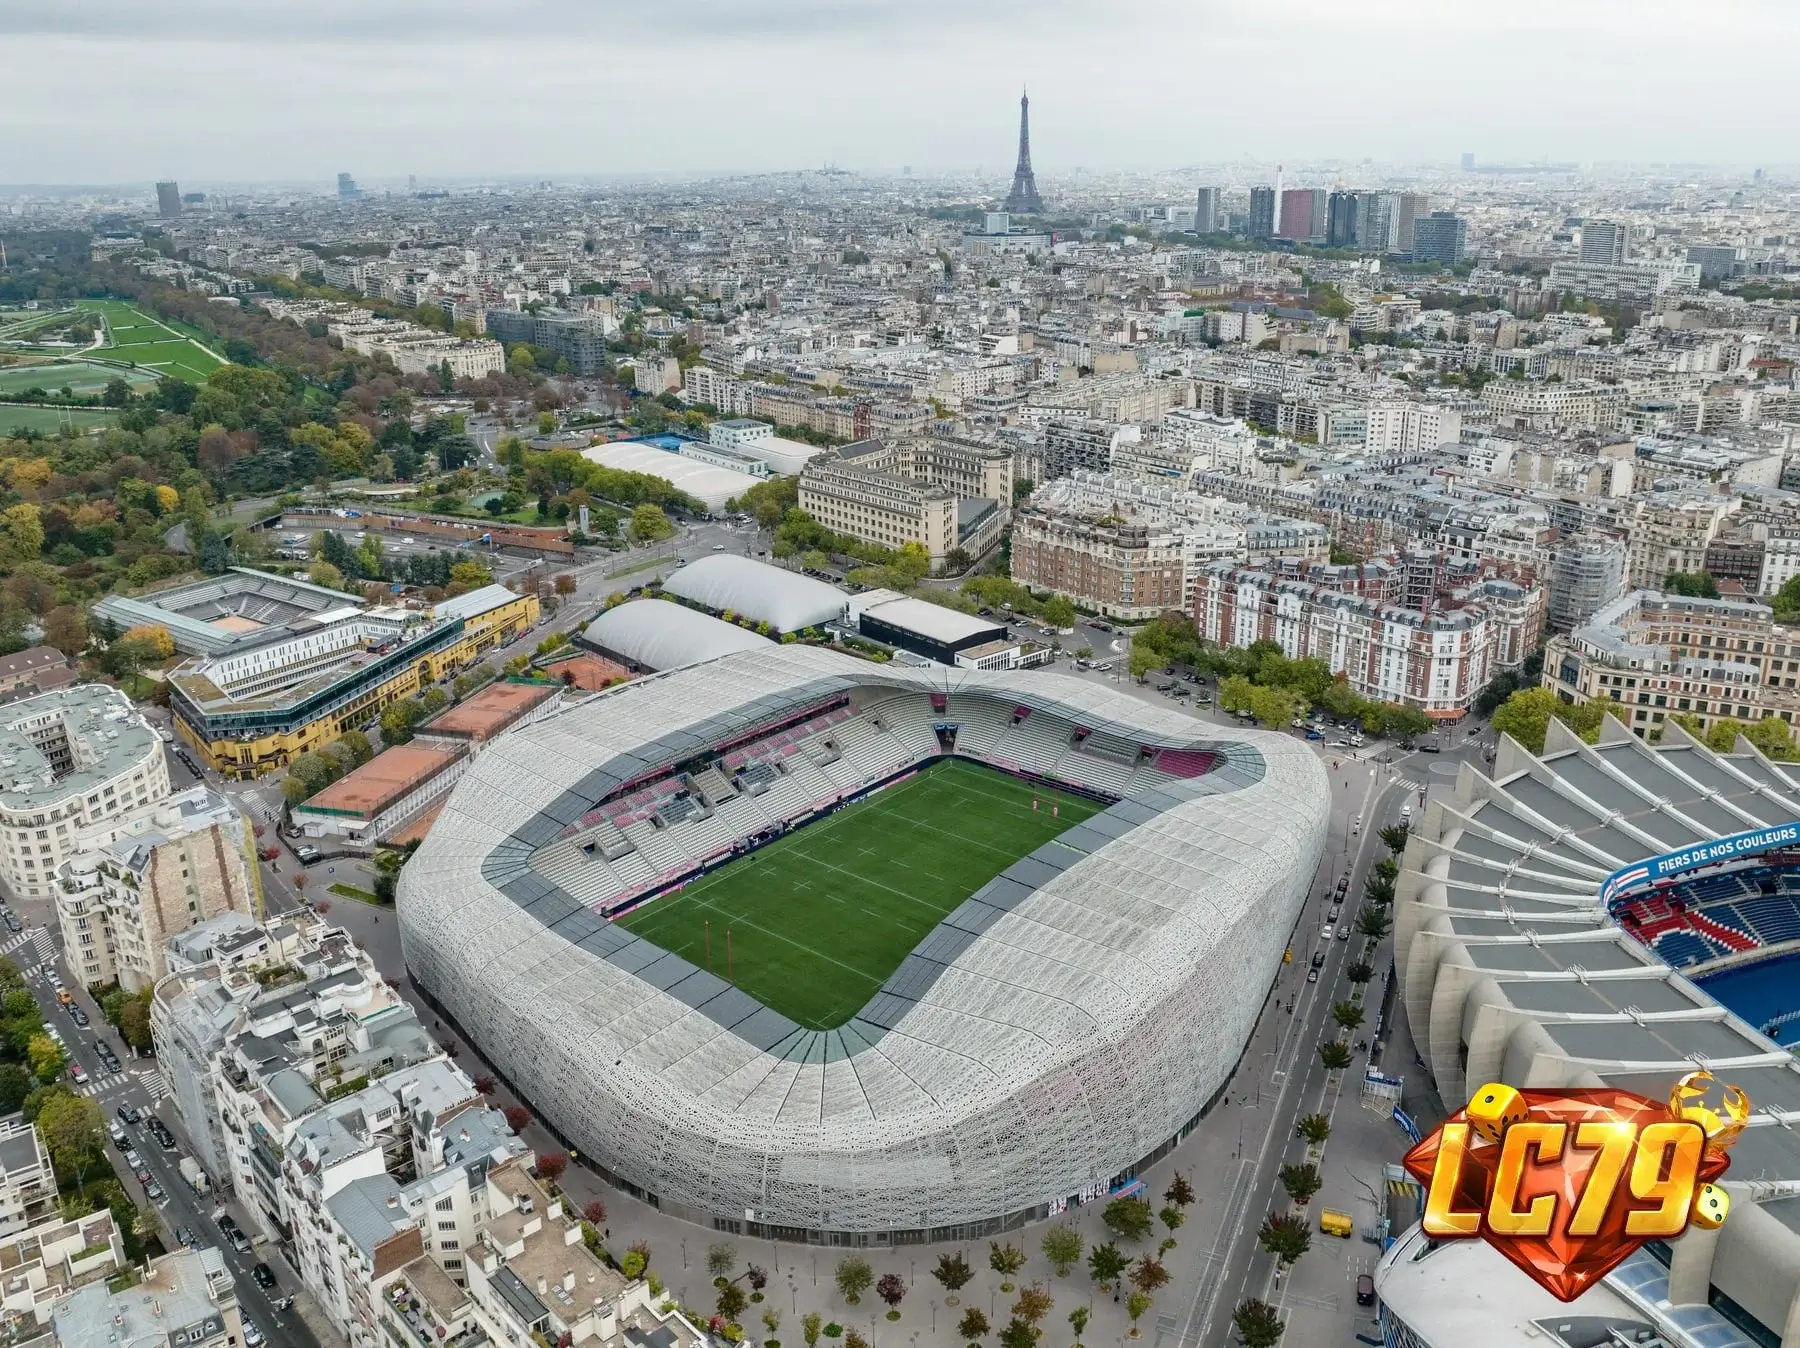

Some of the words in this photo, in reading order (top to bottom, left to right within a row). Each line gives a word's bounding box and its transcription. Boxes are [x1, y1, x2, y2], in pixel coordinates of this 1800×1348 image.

[1658, 853, 1690, 873] FIERS
[1693, 849, 1708, 863] DE
[1710, 842, 1734, 859] NOS
[1736, 828, 1797, 850] COULEURS
